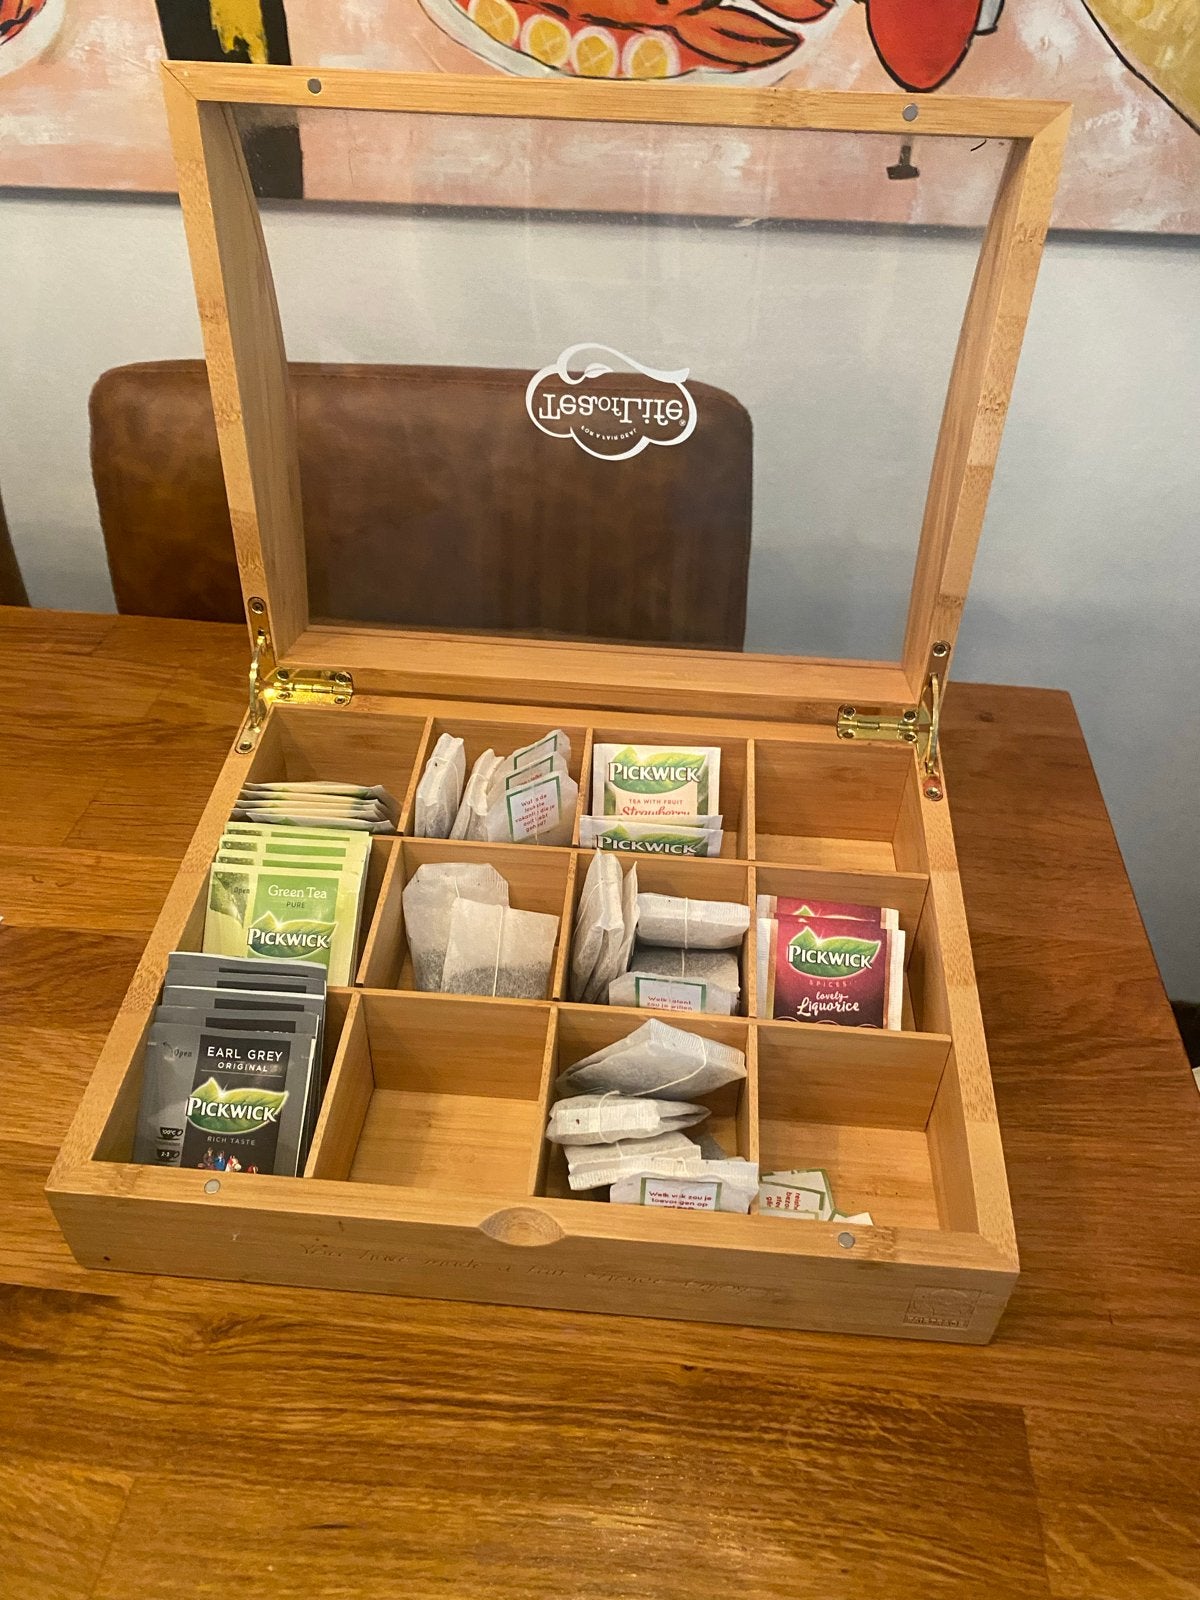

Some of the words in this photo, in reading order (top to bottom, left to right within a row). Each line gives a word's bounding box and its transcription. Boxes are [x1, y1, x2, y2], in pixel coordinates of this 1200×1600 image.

[608, 761, 701, 783] PICKWICK
[595, 834, 697, 854] PICKWICK
[233, 886, 250, 896] Open
[268, 884, 304, 898] Green
[306, 886, 327, 899] Tea
[286, 901, 305, 909] PURE
[247, 928, 330, 949] PICKWICK
[787, 944, 873, 970] PICKWICK
[809, 979, 847, 988] SPICES
[815, 991, 849, 1003] lovely
[796, 997, 860, 1017] Liquorice
[173, 1049, 193, 1059] Open
[207, 1046, 241, 1060] EARL
[247, 1049, 283, 1062] GREY
[217, 1061, 269, 1073] ORIGINAL
[186, 1097, 277, 1123] PICKWICK
[207, 1135, 227, 1144] RICH
[229, 1137, 256, 1146] TASTE
